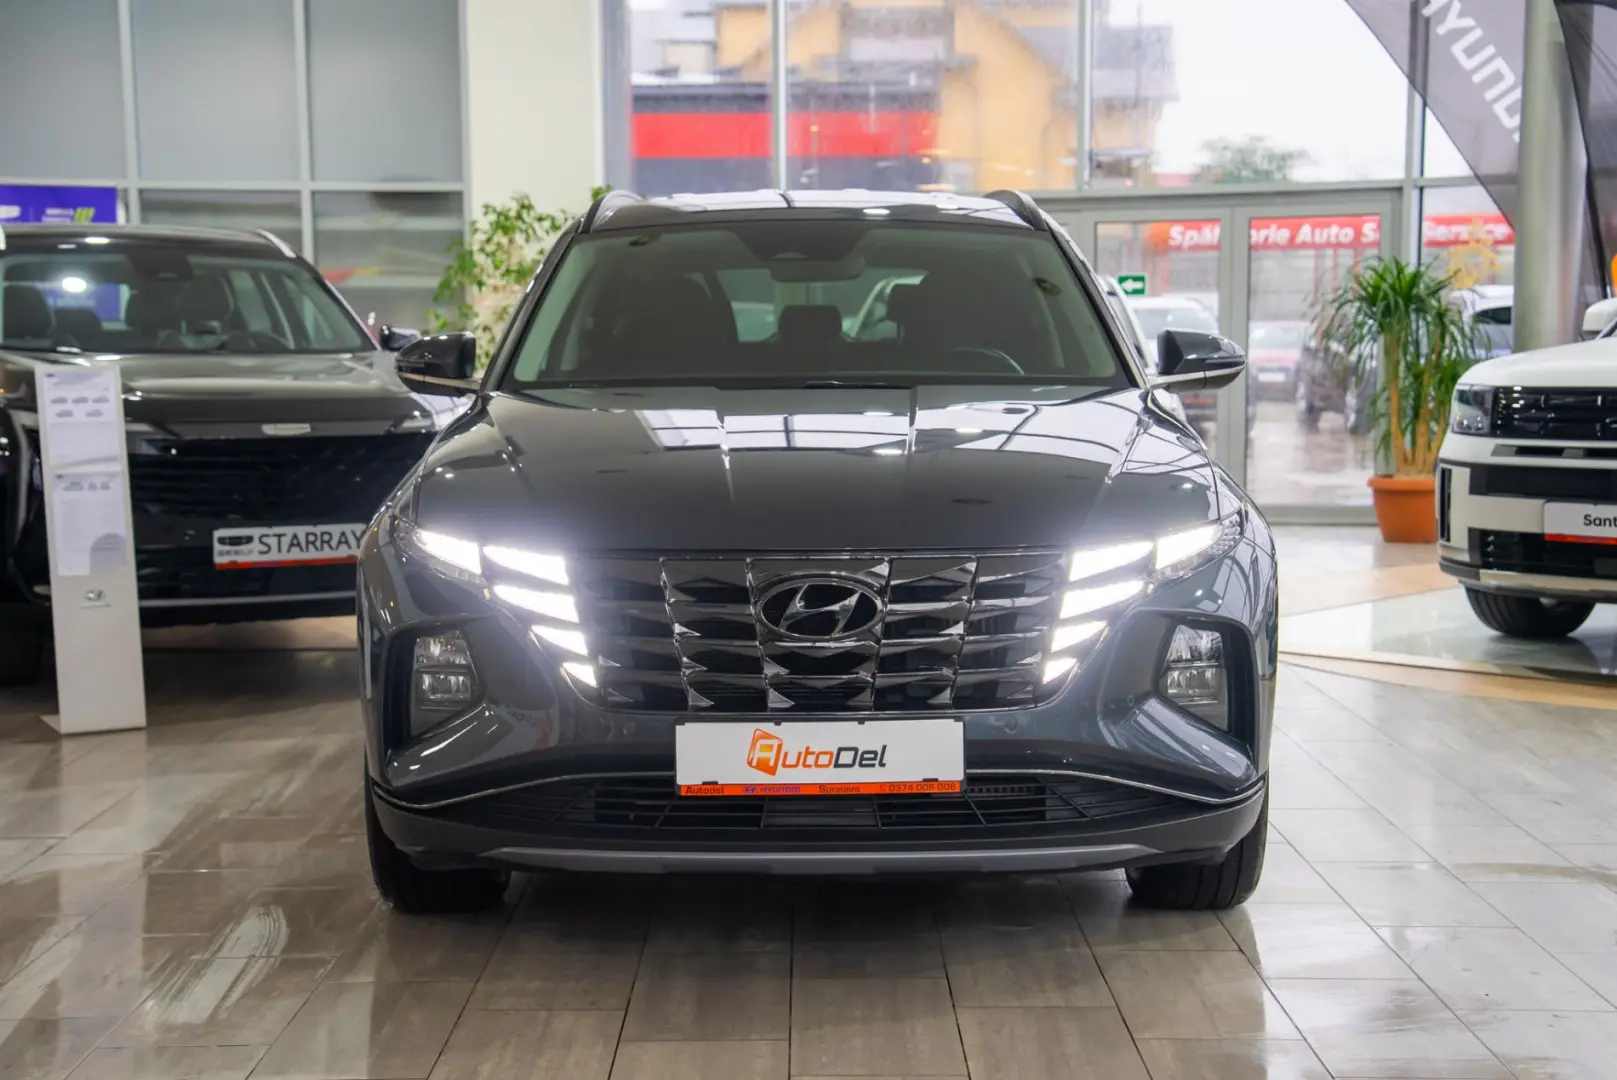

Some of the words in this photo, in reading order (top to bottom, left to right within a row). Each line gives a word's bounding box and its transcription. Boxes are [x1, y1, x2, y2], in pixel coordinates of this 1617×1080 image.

[1421, 0, 1521, 143] YUND
[1294, 223, 1355, 245] Auto
[1422, 221, 1511, 243] Serce
[258, 530, 364, 555] STARRAY
[748, 733, 888, 771] AutoDel
[818, 784, 861, 794] Suceava
[888, 783, 914, 793] 0374
